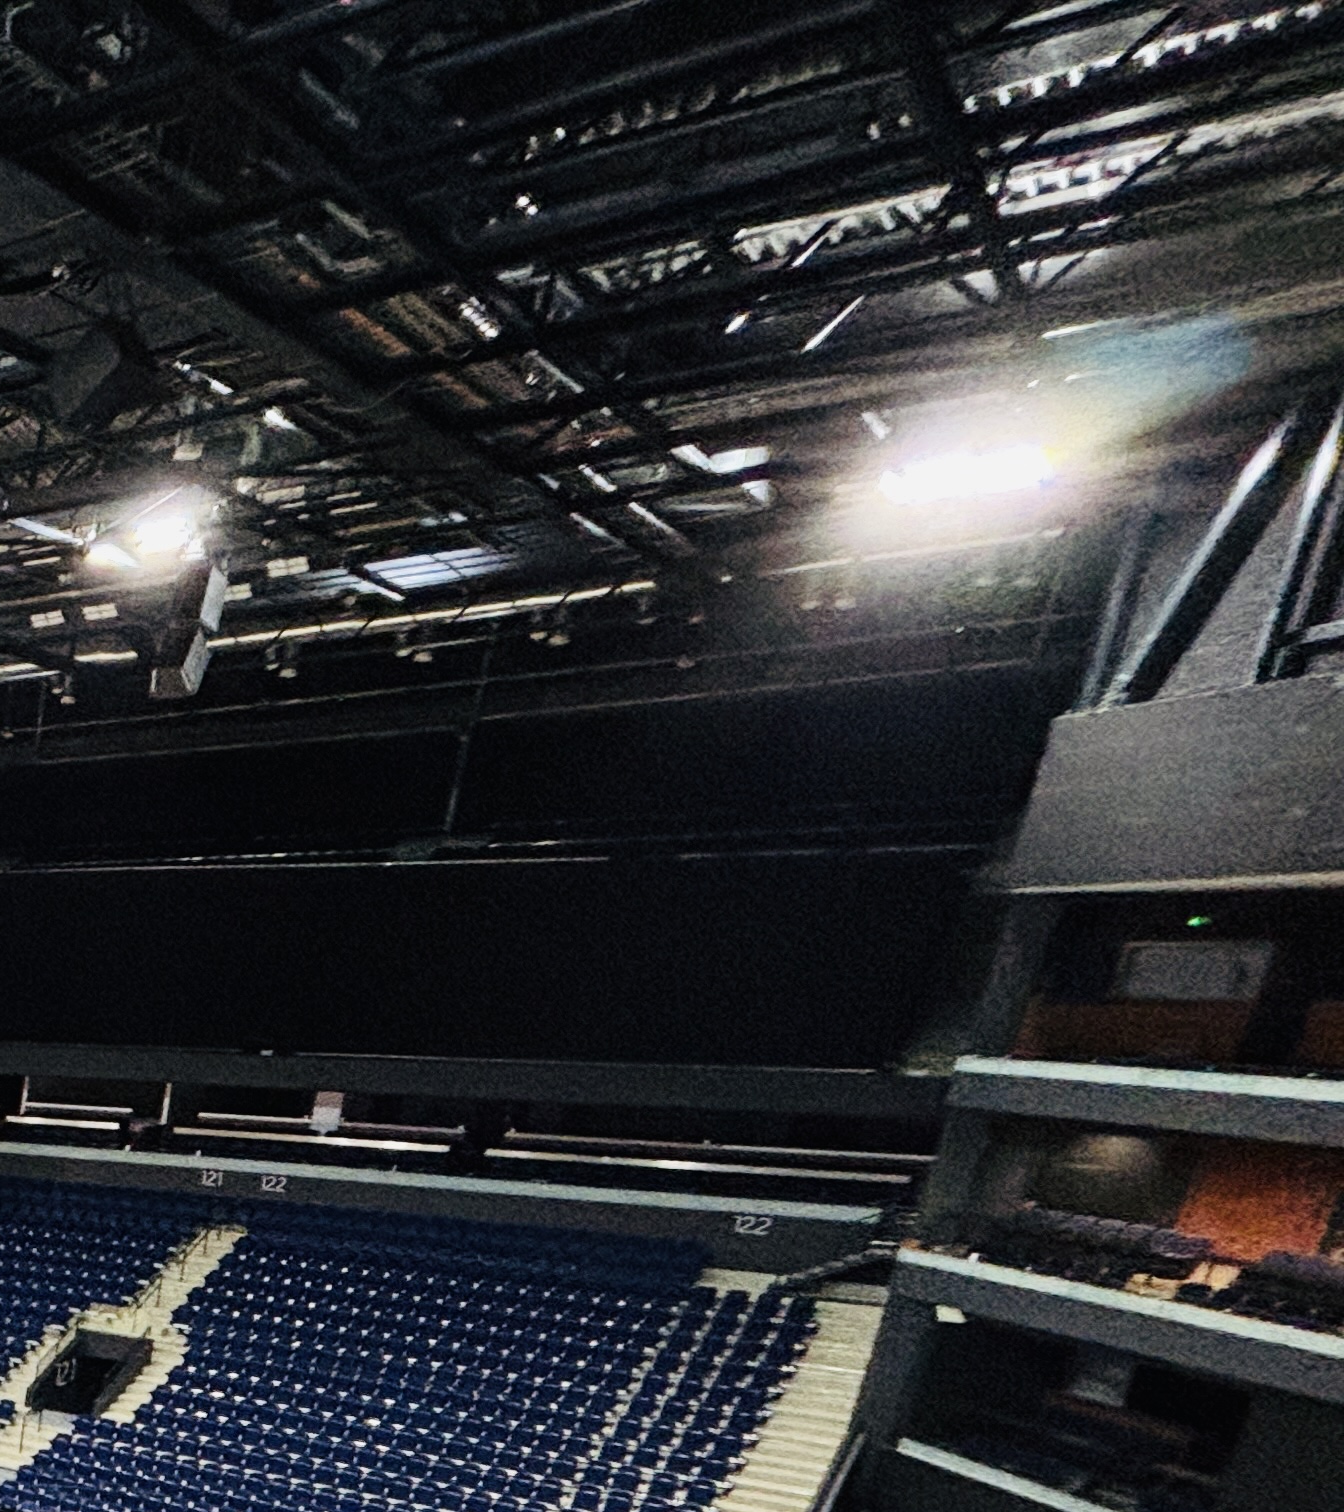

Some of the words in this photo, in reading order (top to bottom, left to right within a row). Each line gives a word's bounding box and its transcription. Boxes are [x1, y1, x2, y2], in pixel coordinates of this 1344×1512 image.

[201, 1169, 224, 1188] 121
[260, 1174, 288, 1193] 122
[731, 1215, 775, 1236] 122
